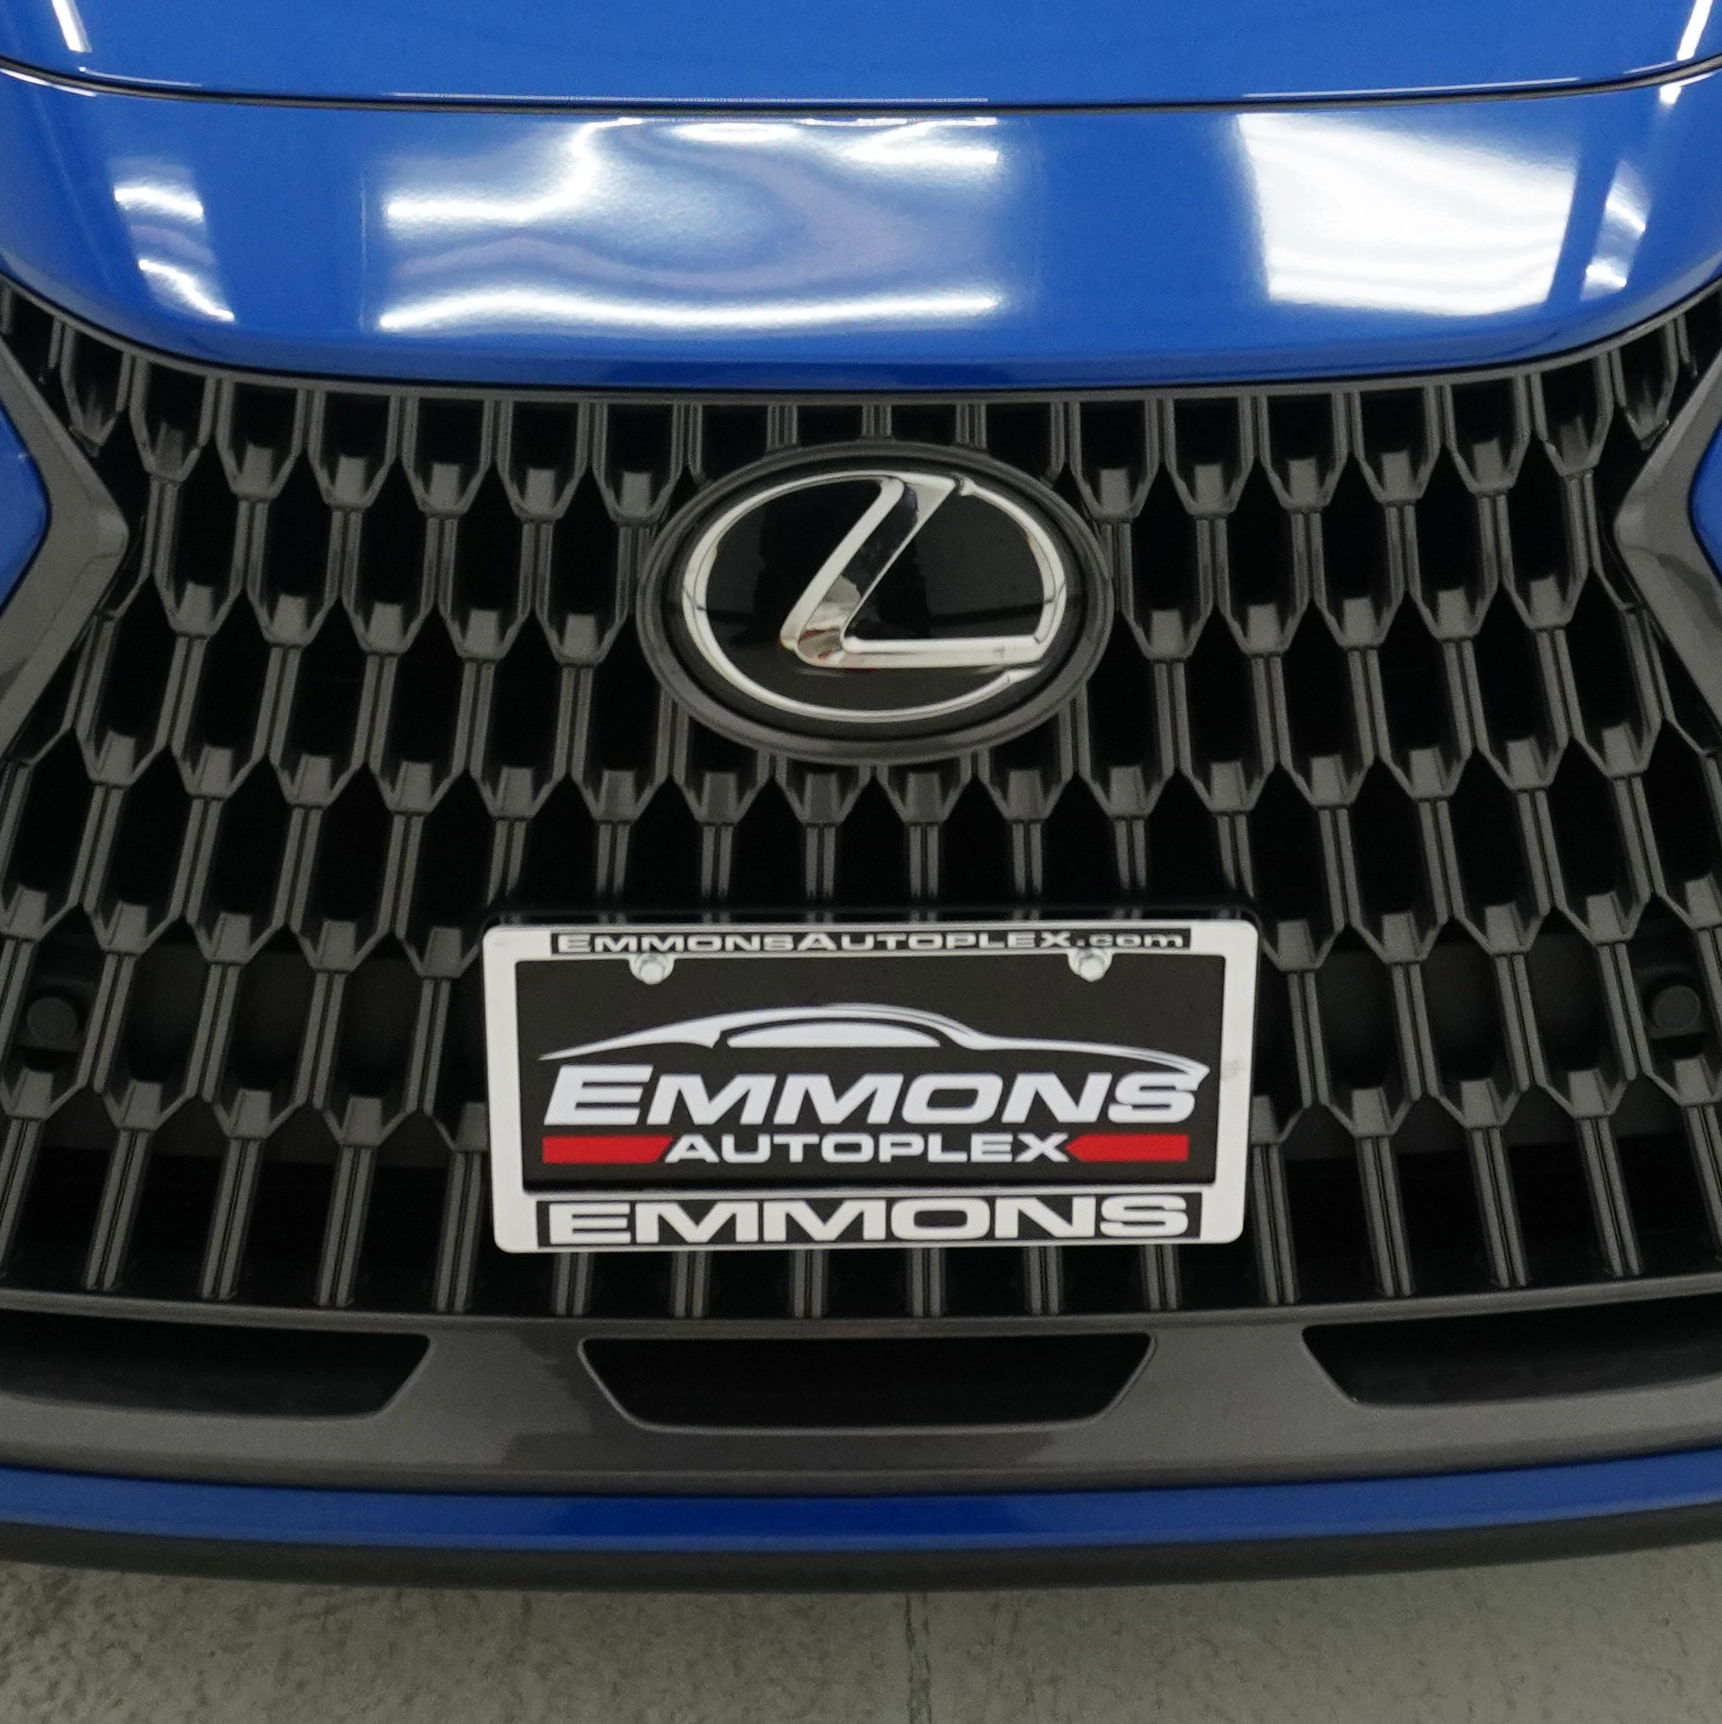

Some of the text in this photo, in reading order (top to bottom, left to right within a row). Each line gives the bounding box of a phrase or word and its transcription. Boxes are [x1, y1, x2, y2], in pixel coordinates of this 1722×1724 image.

[544, 1064, 1198, 1126] EMMONS
[665, 1133, 1070, 1163] AUTOPLEX
[549, 1195, 1189, 1244] EMMONS
